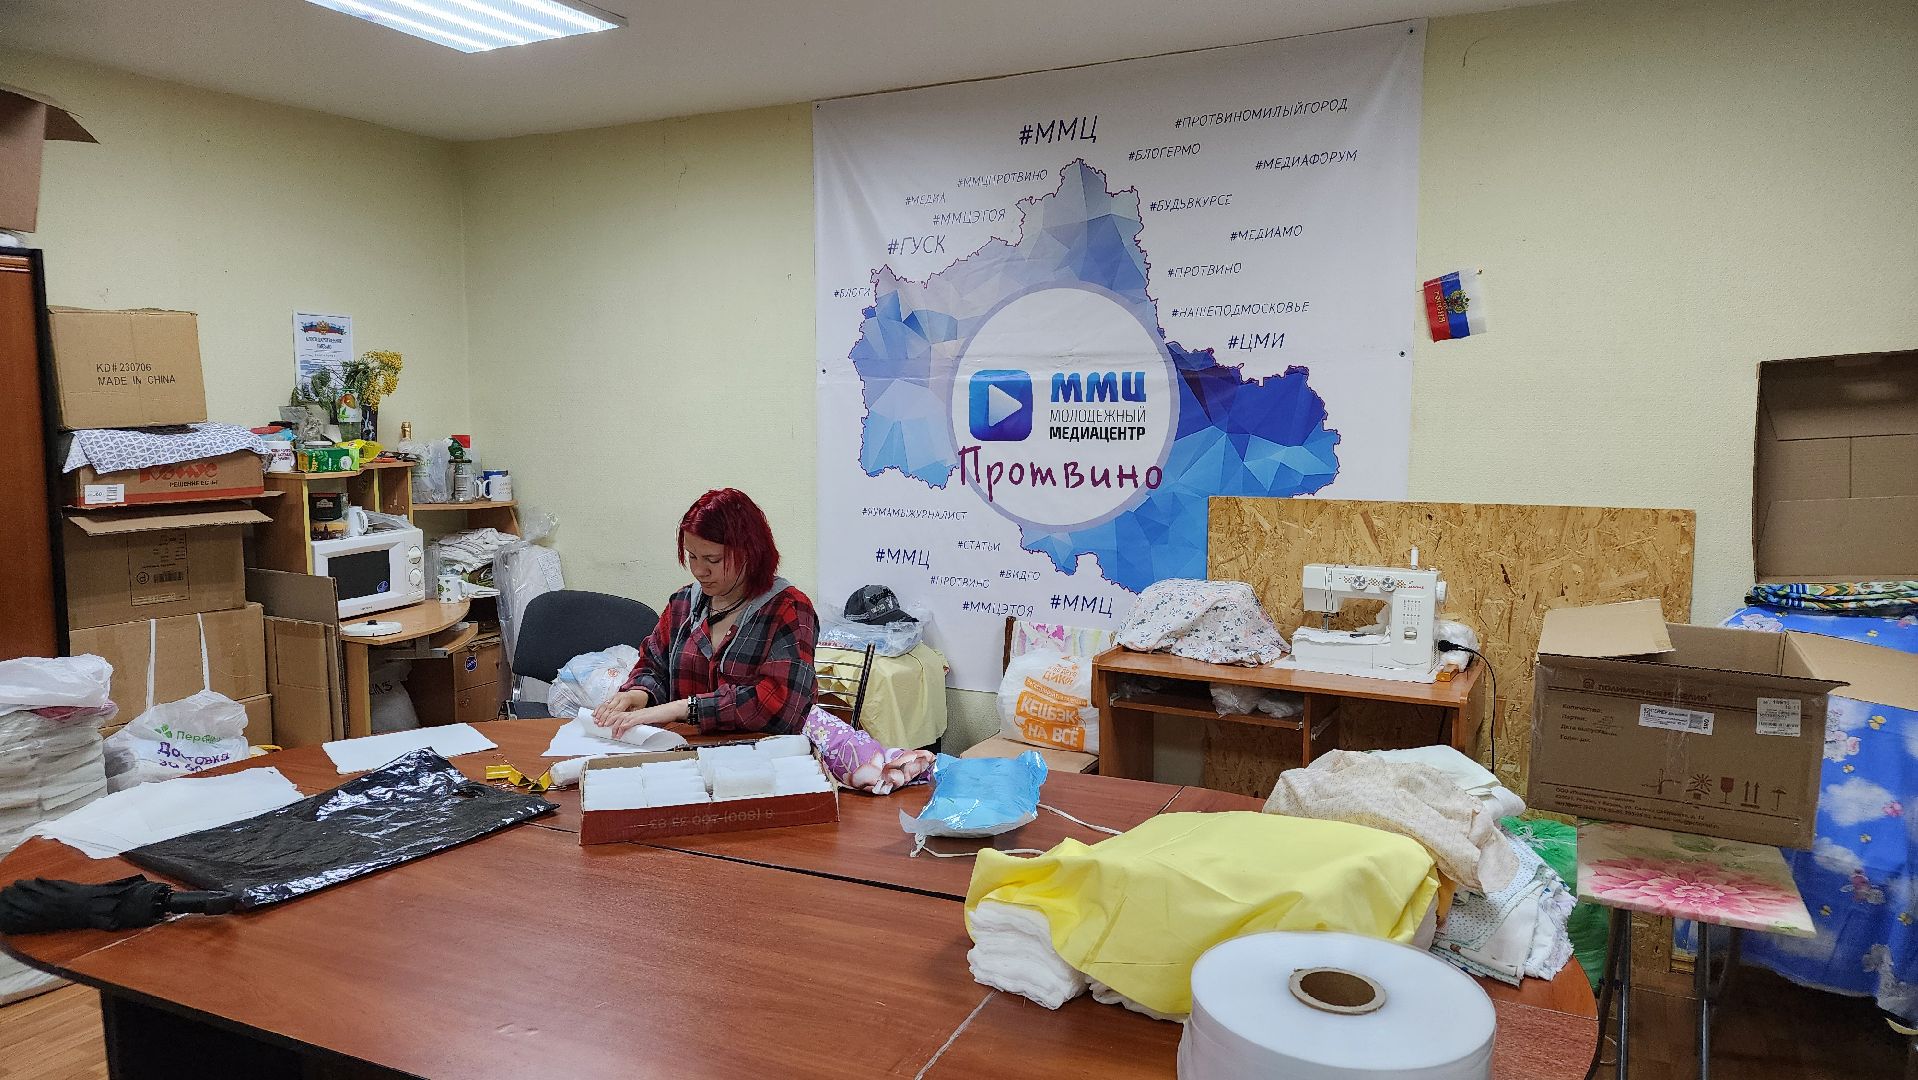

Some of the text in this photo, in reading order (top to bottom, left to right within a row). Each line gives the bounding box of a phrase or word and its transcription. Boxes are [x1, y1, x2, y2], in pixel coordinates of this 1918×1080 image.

[1174, 98, 1349, 129] #ПРОТВИНОМИЛЫЙГОРОД
[1019, 114, 1098, 146] #ММЦ
[1127, 142, 1201, 162] #БЛОГЕРМО
[1255, 149, 1358, 171] #МЕДИАФОРУМ
[904, 192, 947, 206] #МЕДИА
[1149, 193, 1233, 213] #БУДЬВКУРСЕ
[932, 208, 1006, 227] #ММЦЭТОЯ
[1230, 224, 1304, 242] #МЕДИАМО
[887, 234, 947, 256] #ГУСК
[1167, 262, 1243, 279] #ПРОТВИНО
[833, 287, 872, 299] #БЛОГИ
[1170, 301, 1311, 319] #НАШЕПОДМОСКОВЬЕ
[1227, 332, 1286, 353] #ЦМИ
[97, 374, 176, 387] MADE IN CHINA
[1050, 371, 1148, 404] ММЦ
[1049, 406, 1147, 425] МОЛОДЕЖНЫЙ
[1049, 426, 1147, 444] МЕДИАЦЕНТР
[957, 445, 1164, 503] Протвино
[957, 540, 1001, 552] #СТАТЬИ
[875, 547, 930, 571] #ММЦ
[930, 575, 991, 589] #ПРОТВИНО
[962, 600, 1035, 617] #ММЦЭТОЯ
[1049, 594, 1114, 618] #ММЦ
[1021, 695, 1078, 724] КЕШБЭК
[1028, 723, 1048, 740] НА
